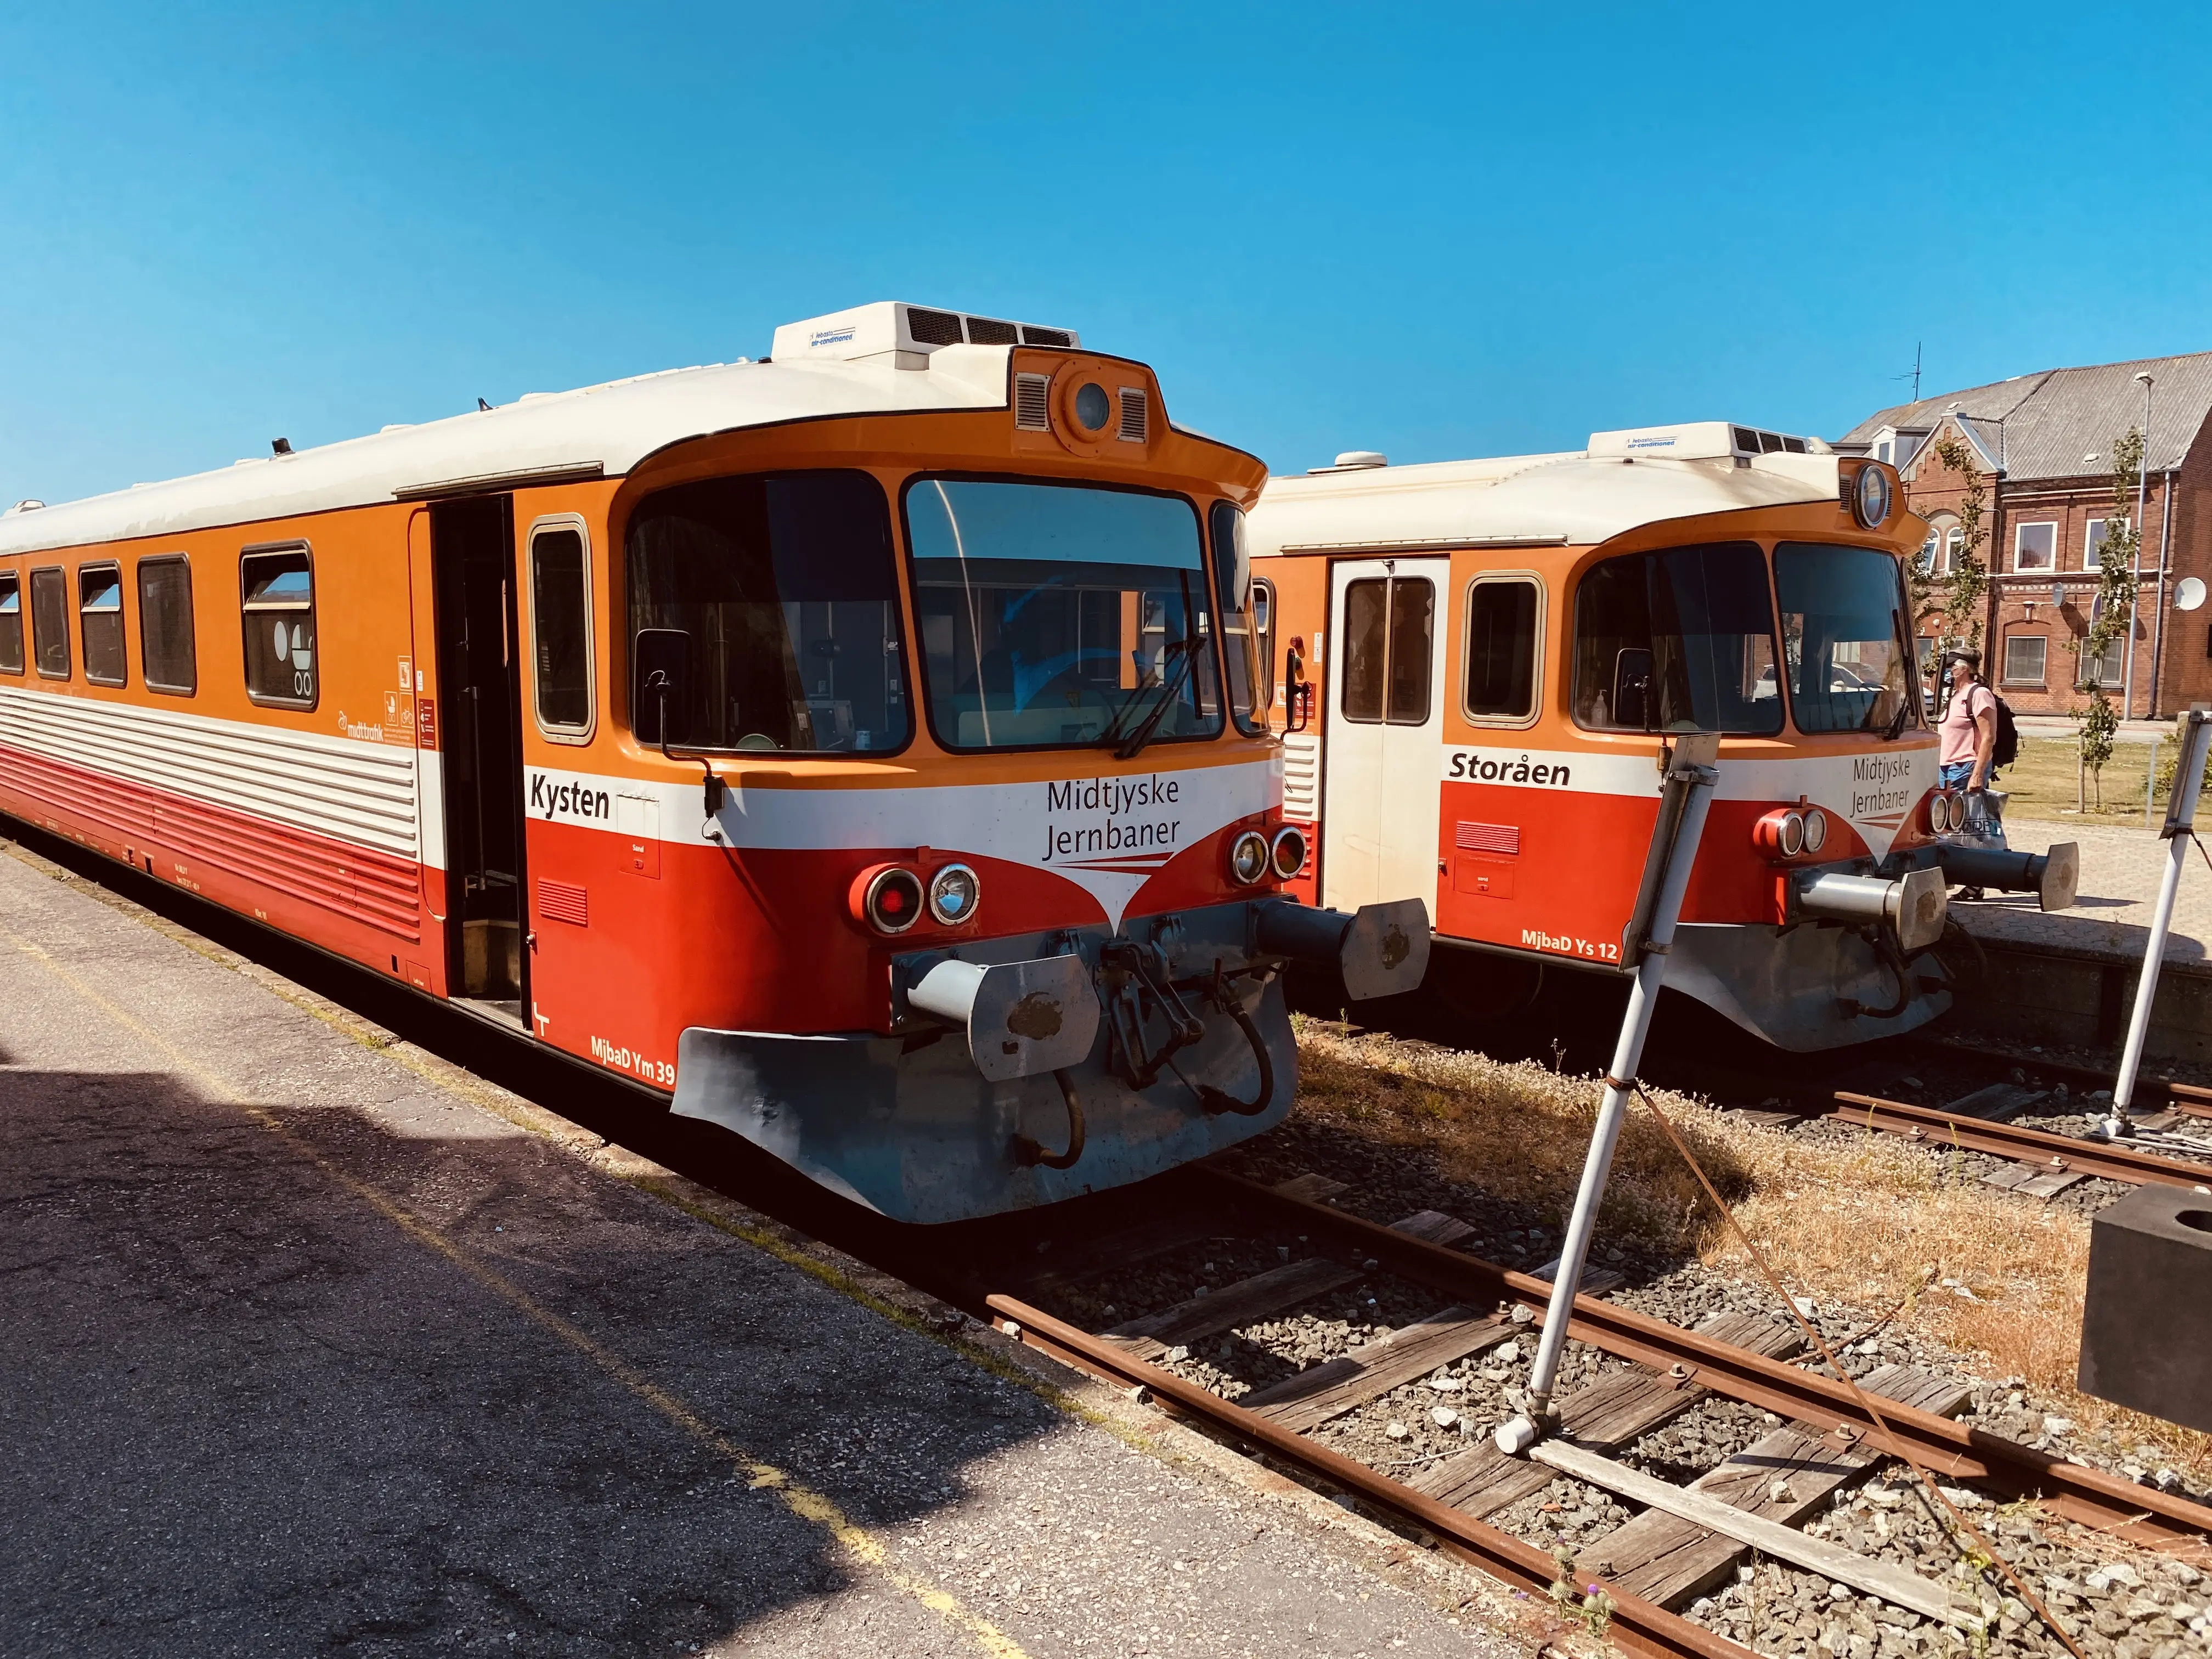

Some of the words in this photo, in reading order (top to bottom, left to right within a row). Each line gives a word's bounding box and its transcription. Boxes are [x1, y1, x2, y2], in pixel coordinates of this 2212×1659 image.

[811, 333, 853, 346] air-conditioned
[1627, 441, 1675, 449] air-conditioned
[1449, 753, 1571, 786] Storåen
[1853, 753, 1910, 784] Midtjyske
[531, 774, 610, 819] Kysten
[1048, 774, 1178, 815] Midtjyske
[1849, 787, 1909, 818] Jernbaner
[1042, 819, 1180, 861] Jernbaner
[1521, 929, 1572, 952] MjbaD
[1575, 939, 1594, 956] Ys
[1598, 943, 1617, 960] 12
[591, 1035, 631, 1069] MjbaD
[631, 1051, 654, 1079] Ym
[657, 1060, 675, 1086] 39
